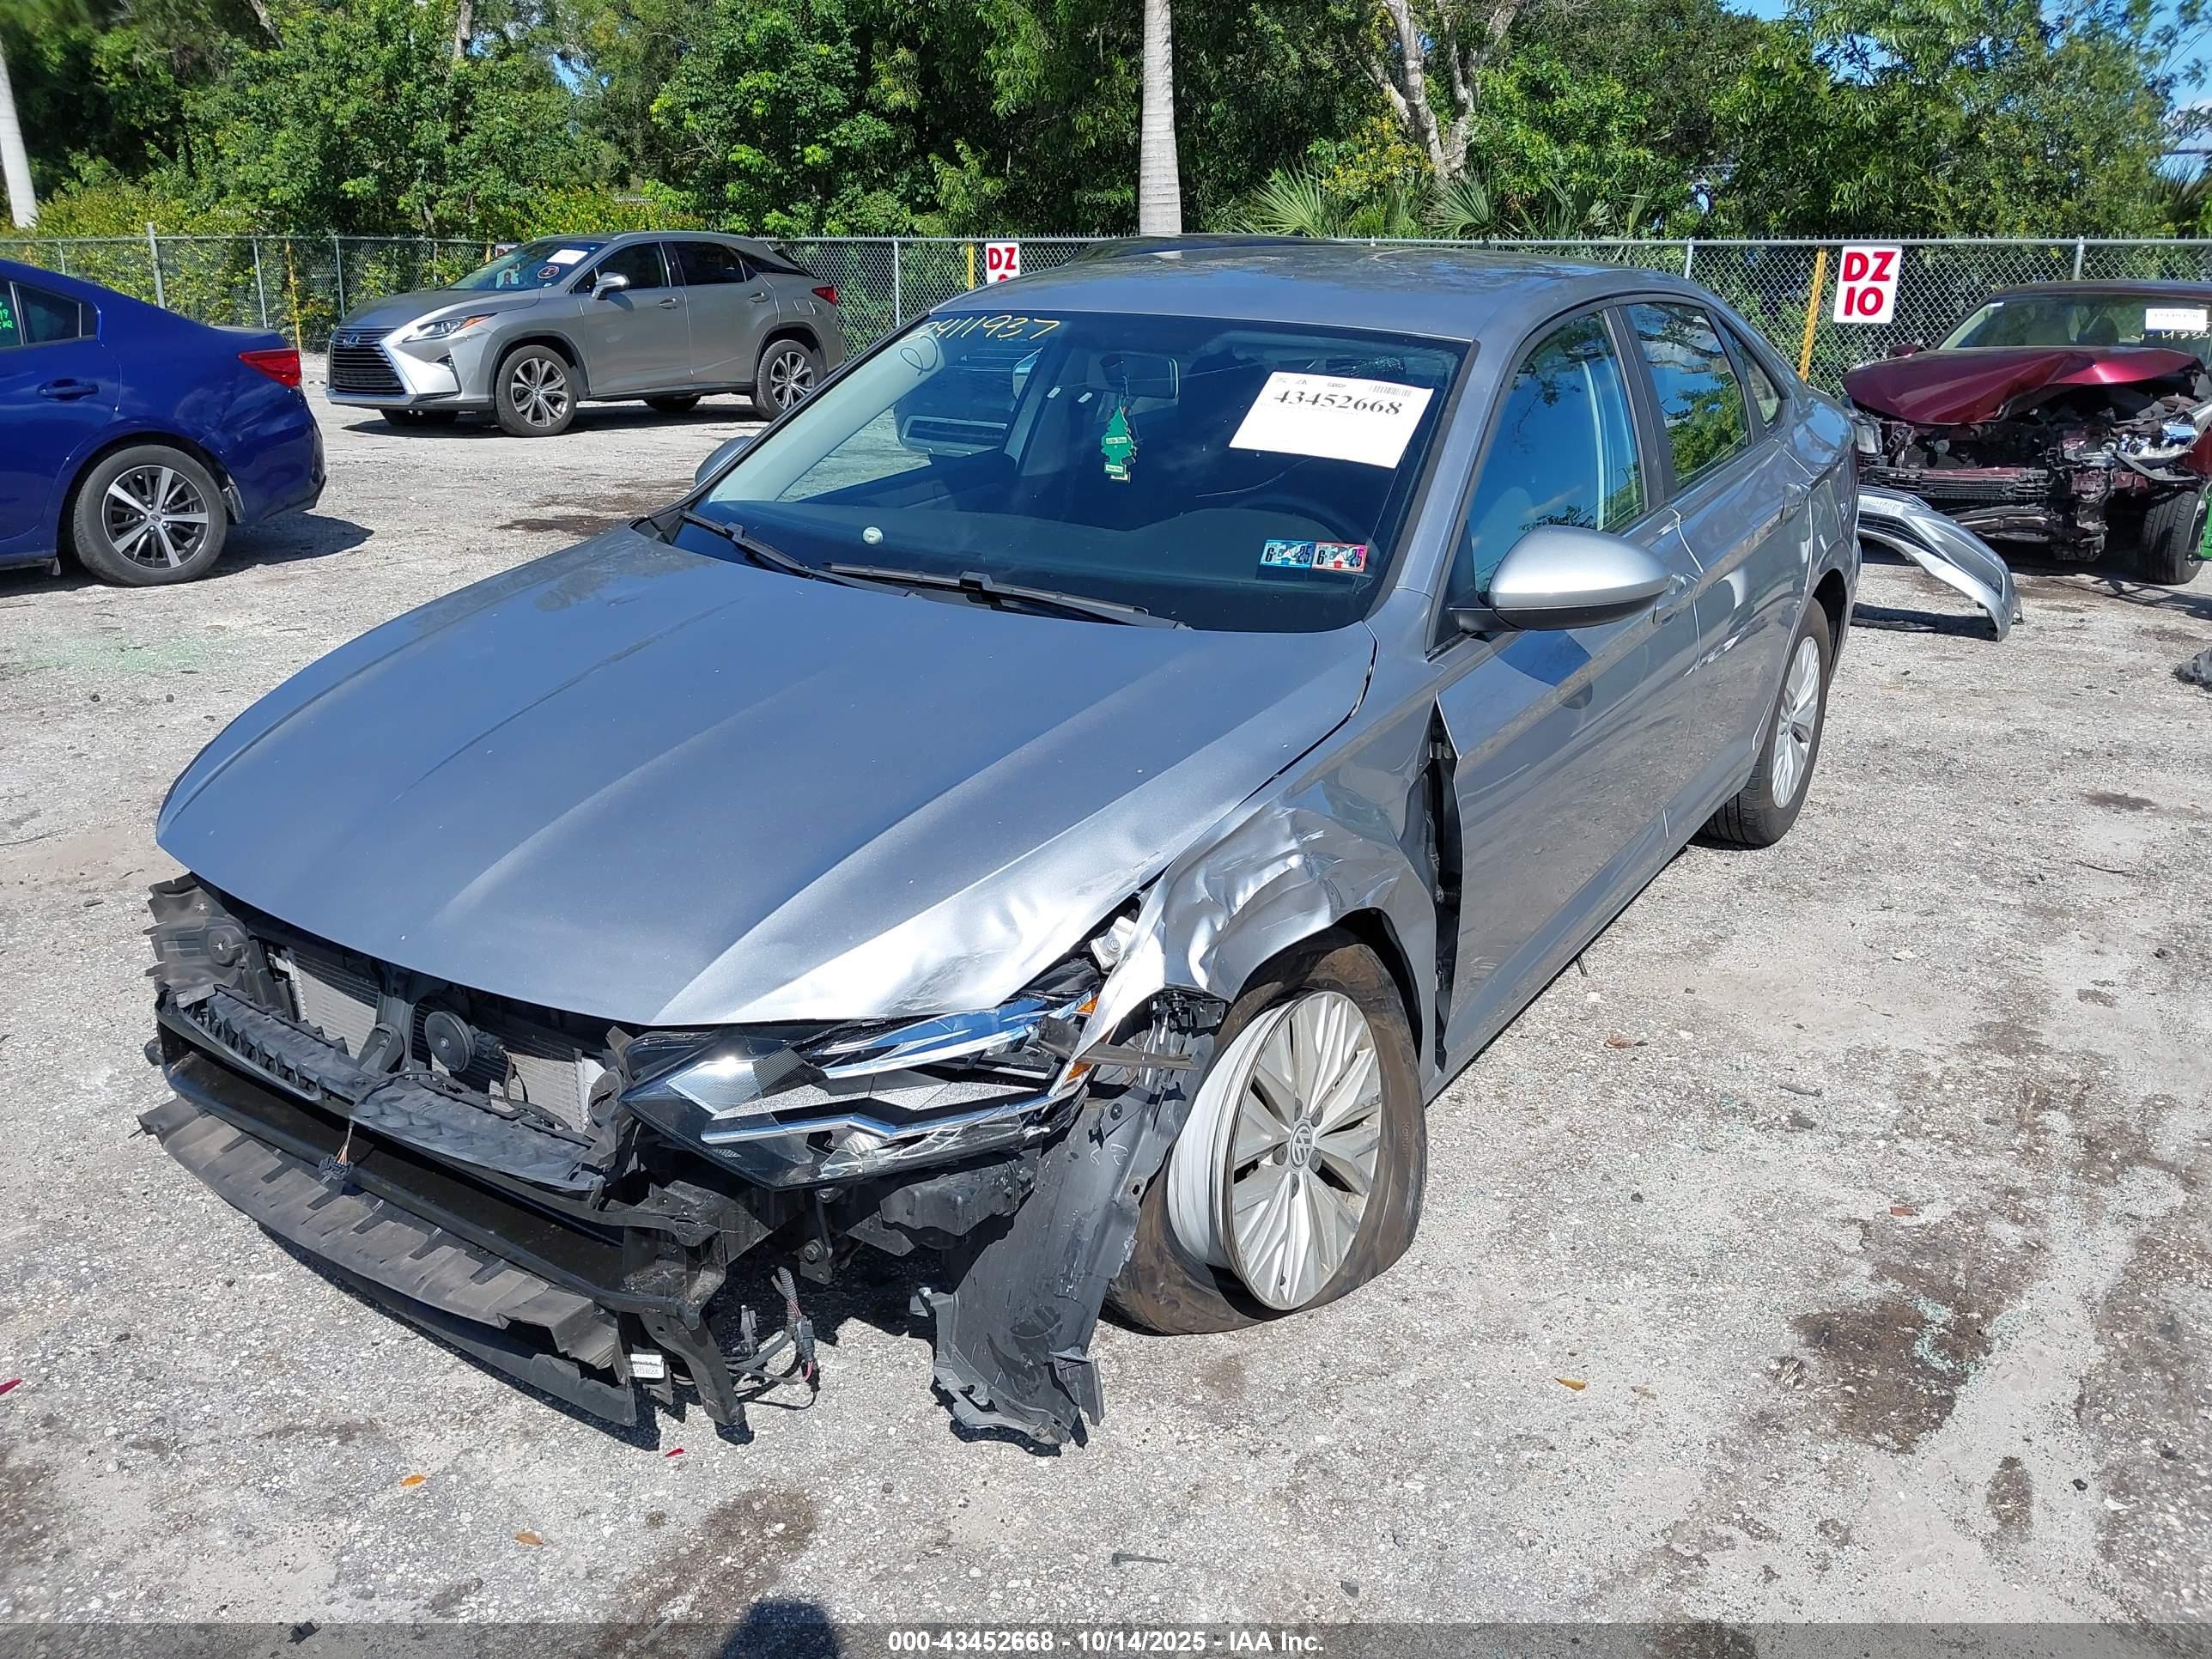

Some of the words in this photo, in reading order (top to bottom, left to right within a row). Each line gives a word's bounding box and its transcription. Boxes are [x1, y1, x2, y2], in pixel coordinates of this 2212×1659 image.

[988, 246, 1017, 270] DZ
[1842, 251, 1896, 282] DZ
[1273, 389, 1403, 416] 43452668
